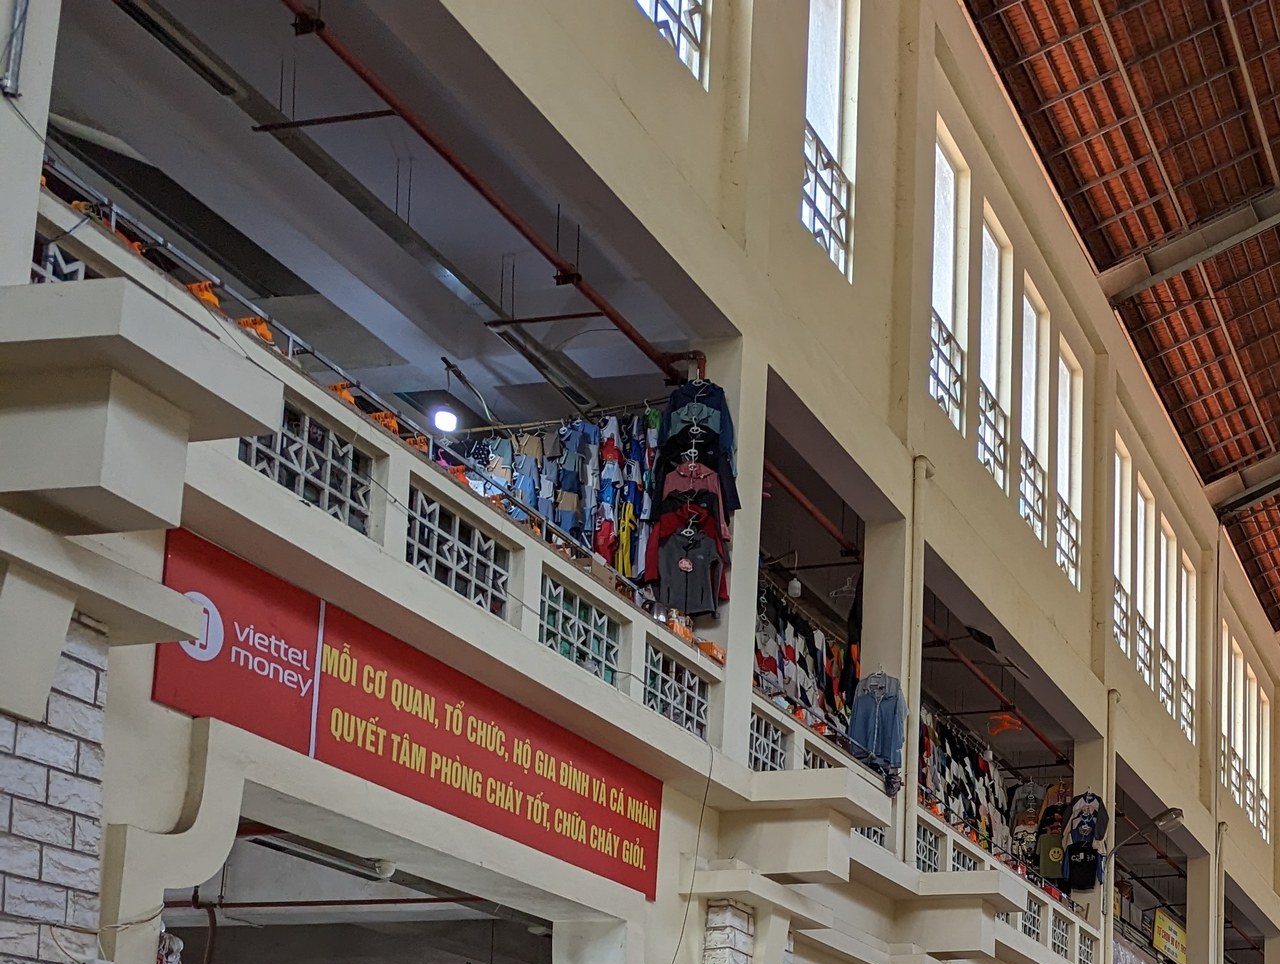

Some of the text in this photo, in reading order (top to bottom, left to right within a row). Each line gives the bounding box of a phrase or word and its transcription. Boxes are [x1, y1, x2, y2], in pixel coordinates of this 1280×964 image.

[230, 646, 313, 697] money
[233, 621, 311, 671] viettel
[322, 642, 657, 832] MỖI CƠ QUAN, TỔ CHỨC, HỘ GIA ĐÌNH VÀ CÁ NHÂN
[330, 707, 647, 871] QUYẾT TÂM PHÒNG CHÁY TỐT, CHỮA CHÁY GIỎI.
